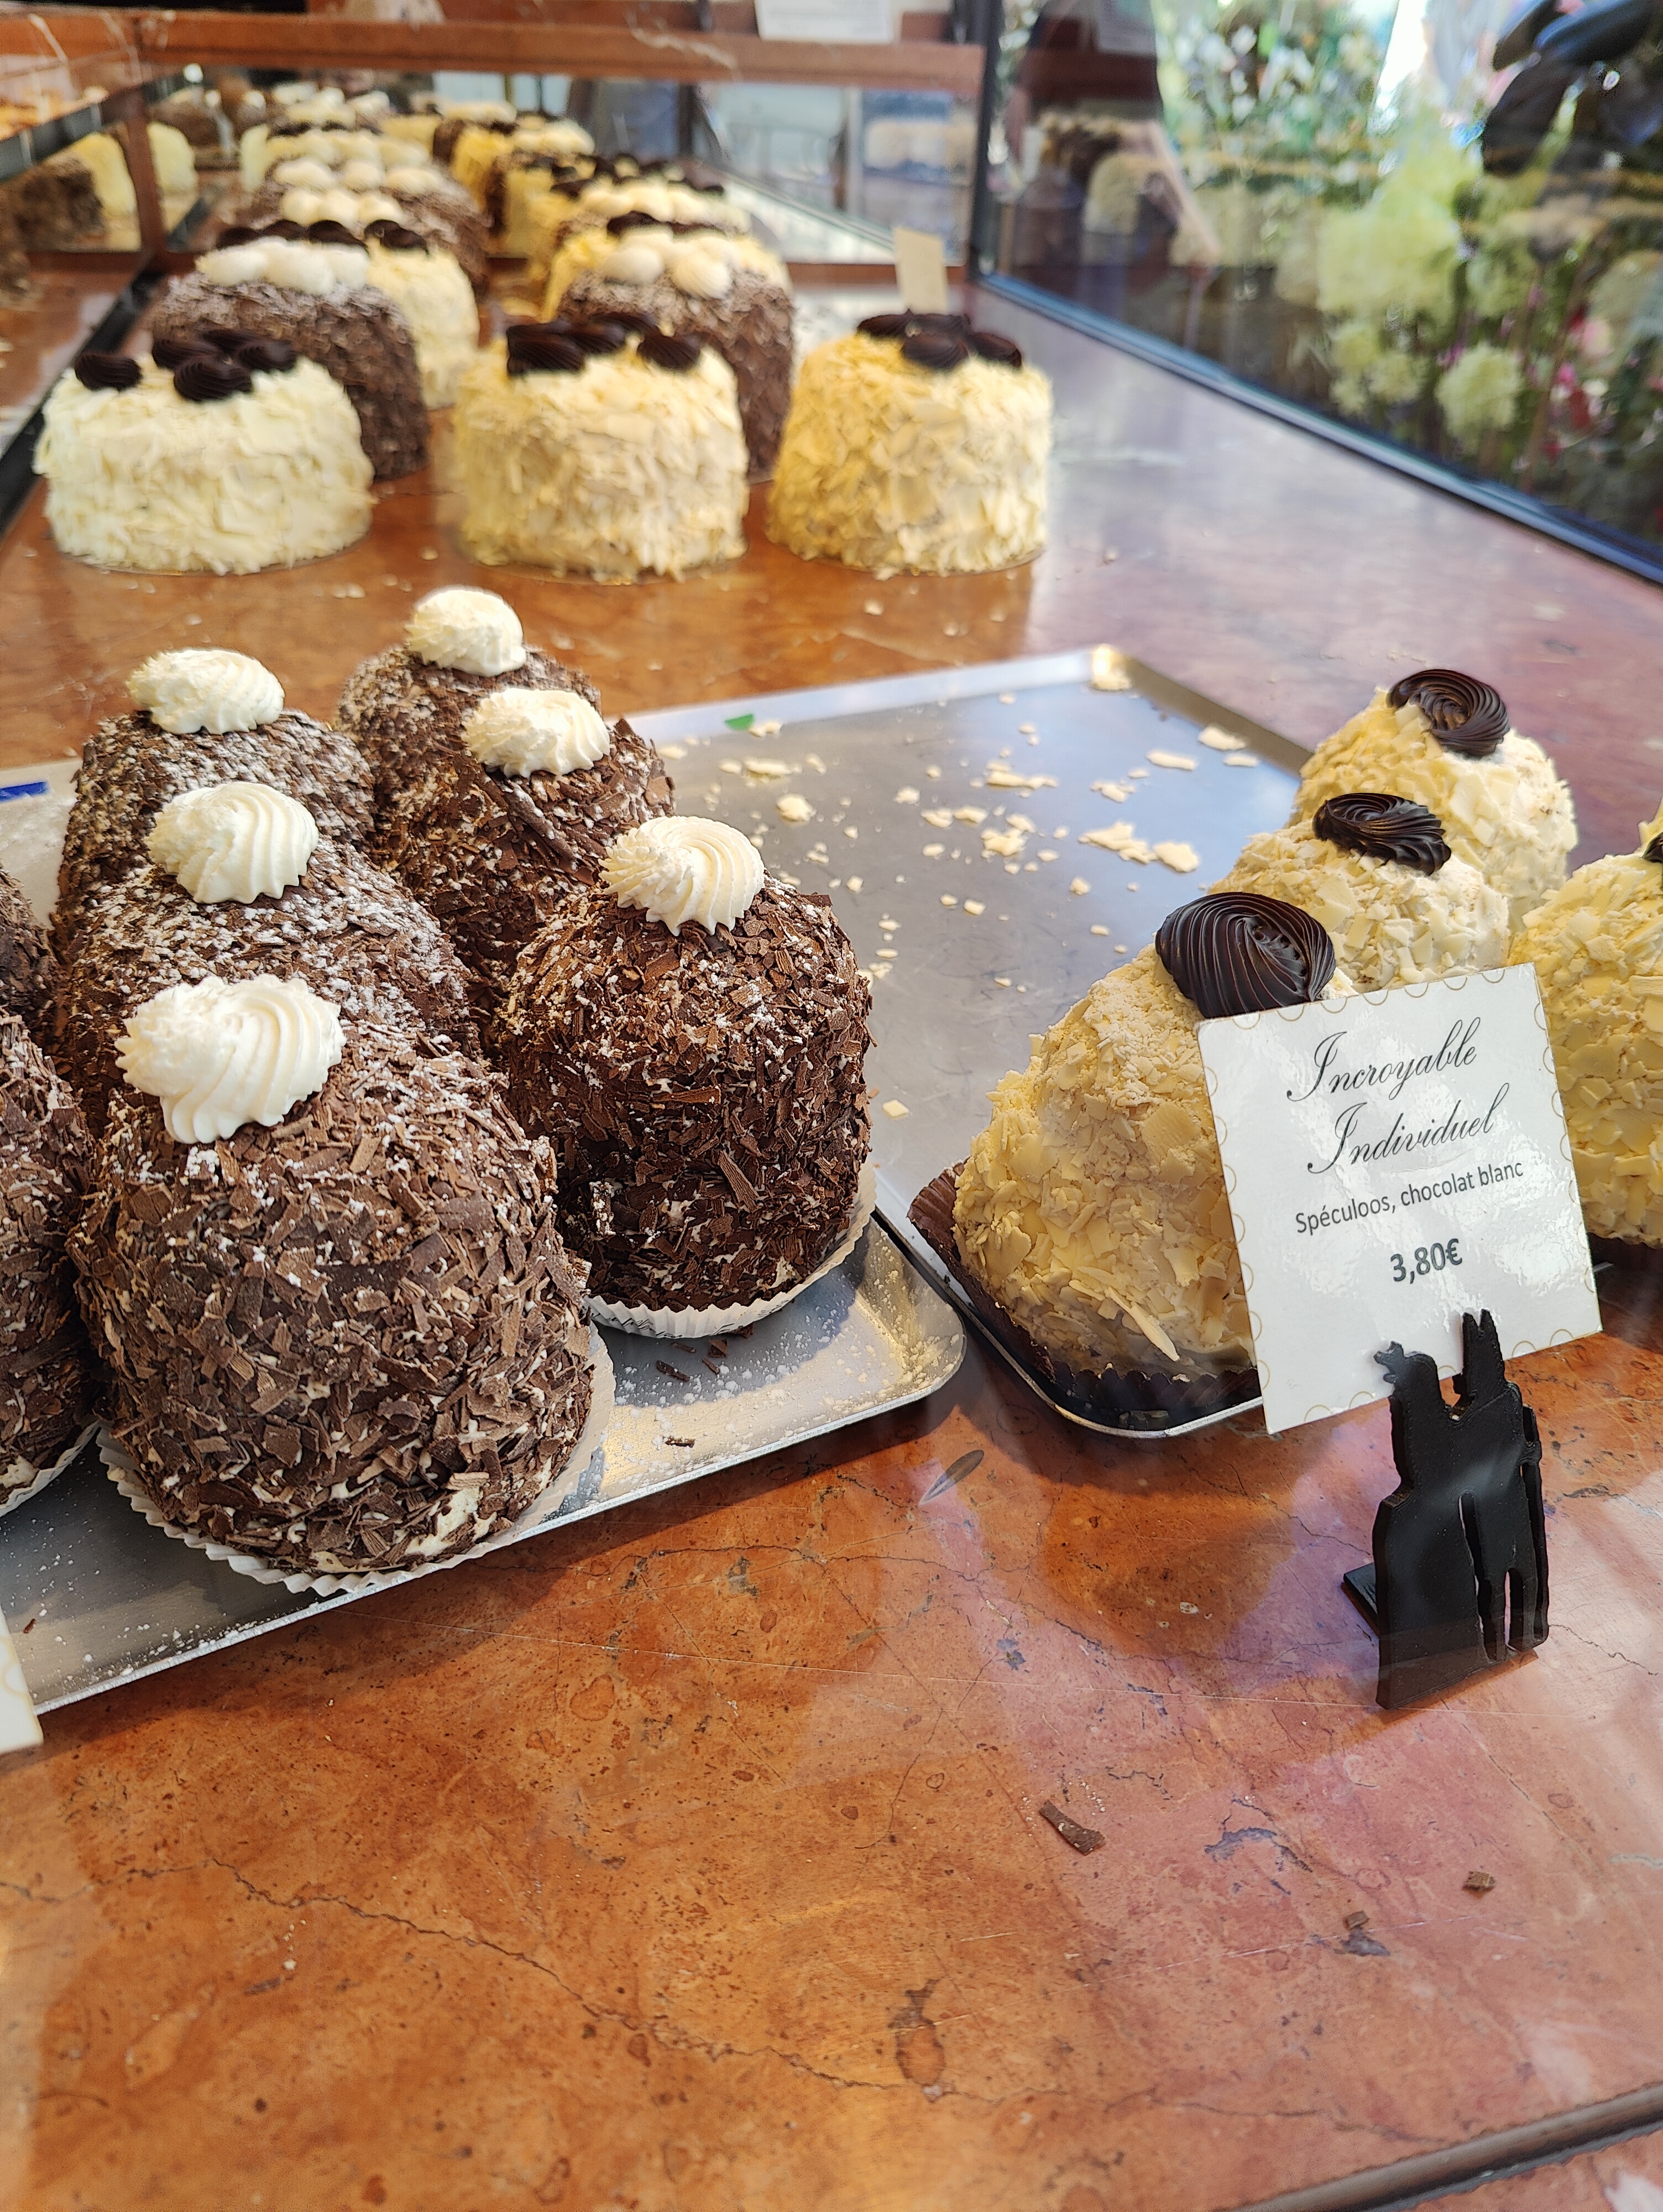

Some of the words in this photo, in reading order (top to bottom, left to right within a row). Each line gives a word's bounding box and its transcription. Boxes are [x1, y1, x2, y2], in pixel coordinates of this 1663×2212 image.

[1286, 1016, 1481, 1103] Incroyable
[1307, 1082, 1510, 1175] Individuel
[1295, 1194, 1397, 1235] Spéculoos,
[1400, 1171, 1474, 1206] chocolat
[1479, 1159, 1524, 1192] blanc
[1389, 1238, 1463, 1284] 3,80€
